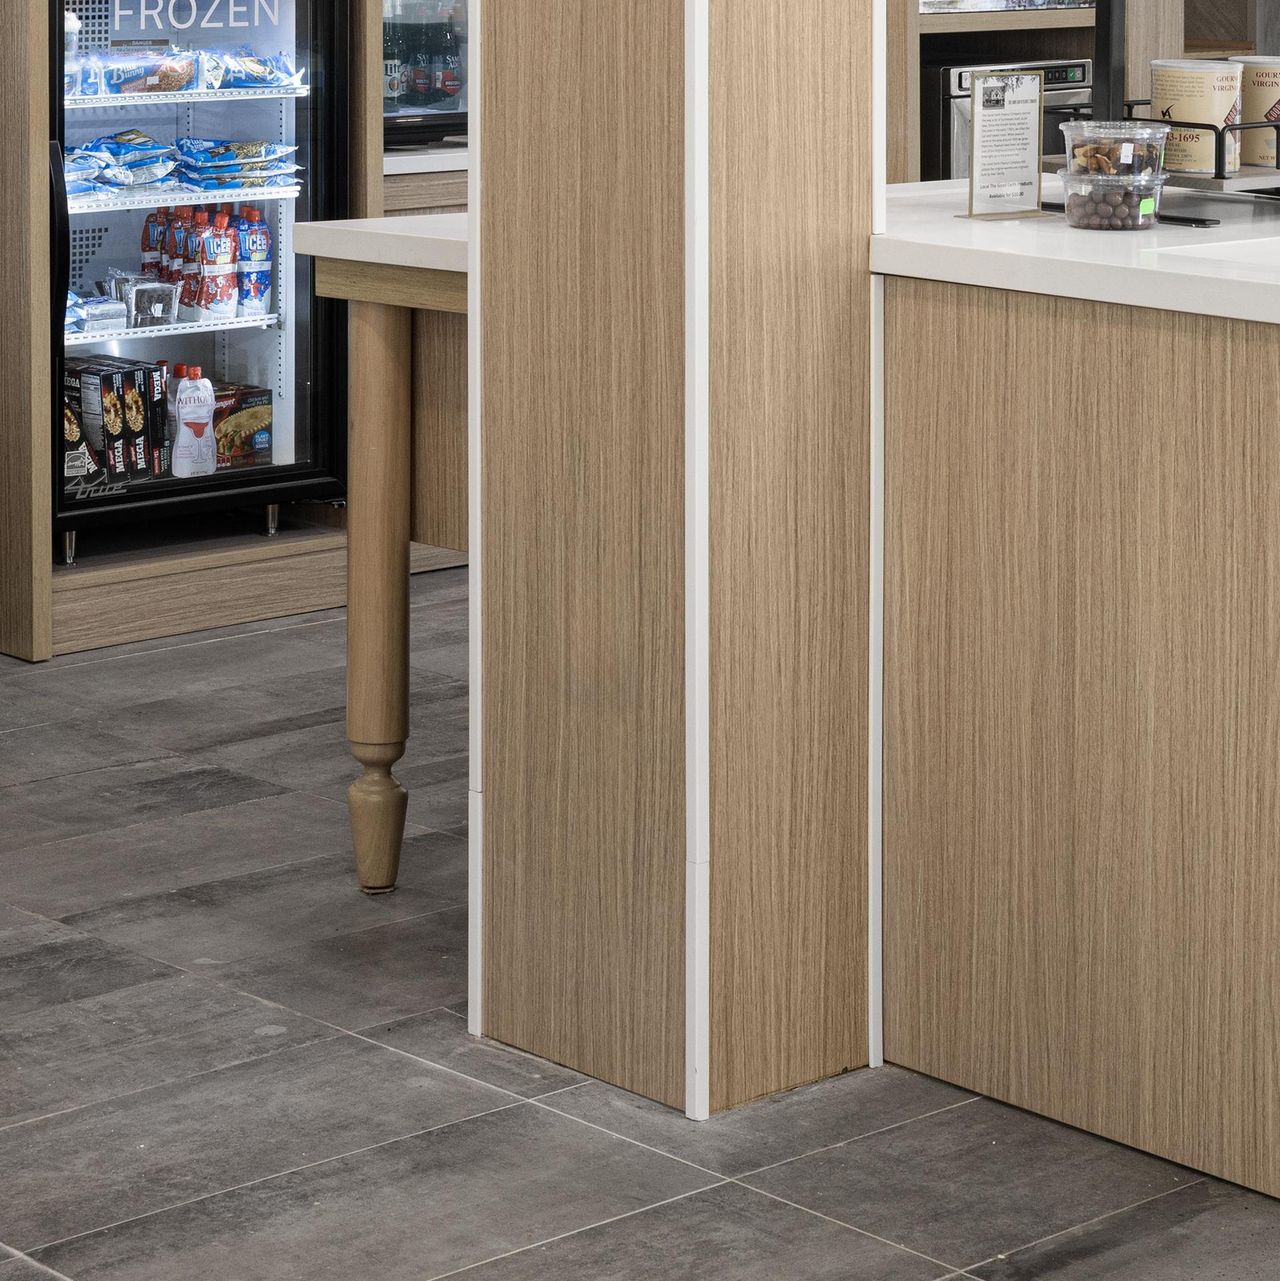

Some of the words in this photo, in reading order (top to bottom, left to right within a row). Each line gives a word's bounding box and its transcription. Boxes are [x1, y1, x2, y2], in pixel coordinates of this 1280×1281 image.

[1216, 75, 1237, 83] GOUR
[1212, 84, 1237, 92] VIRGIN
[210, 237, 232, 253] ICEE
[246, 232, 266, 251] ICEE
[152, 371, 162, 402] MEGA
